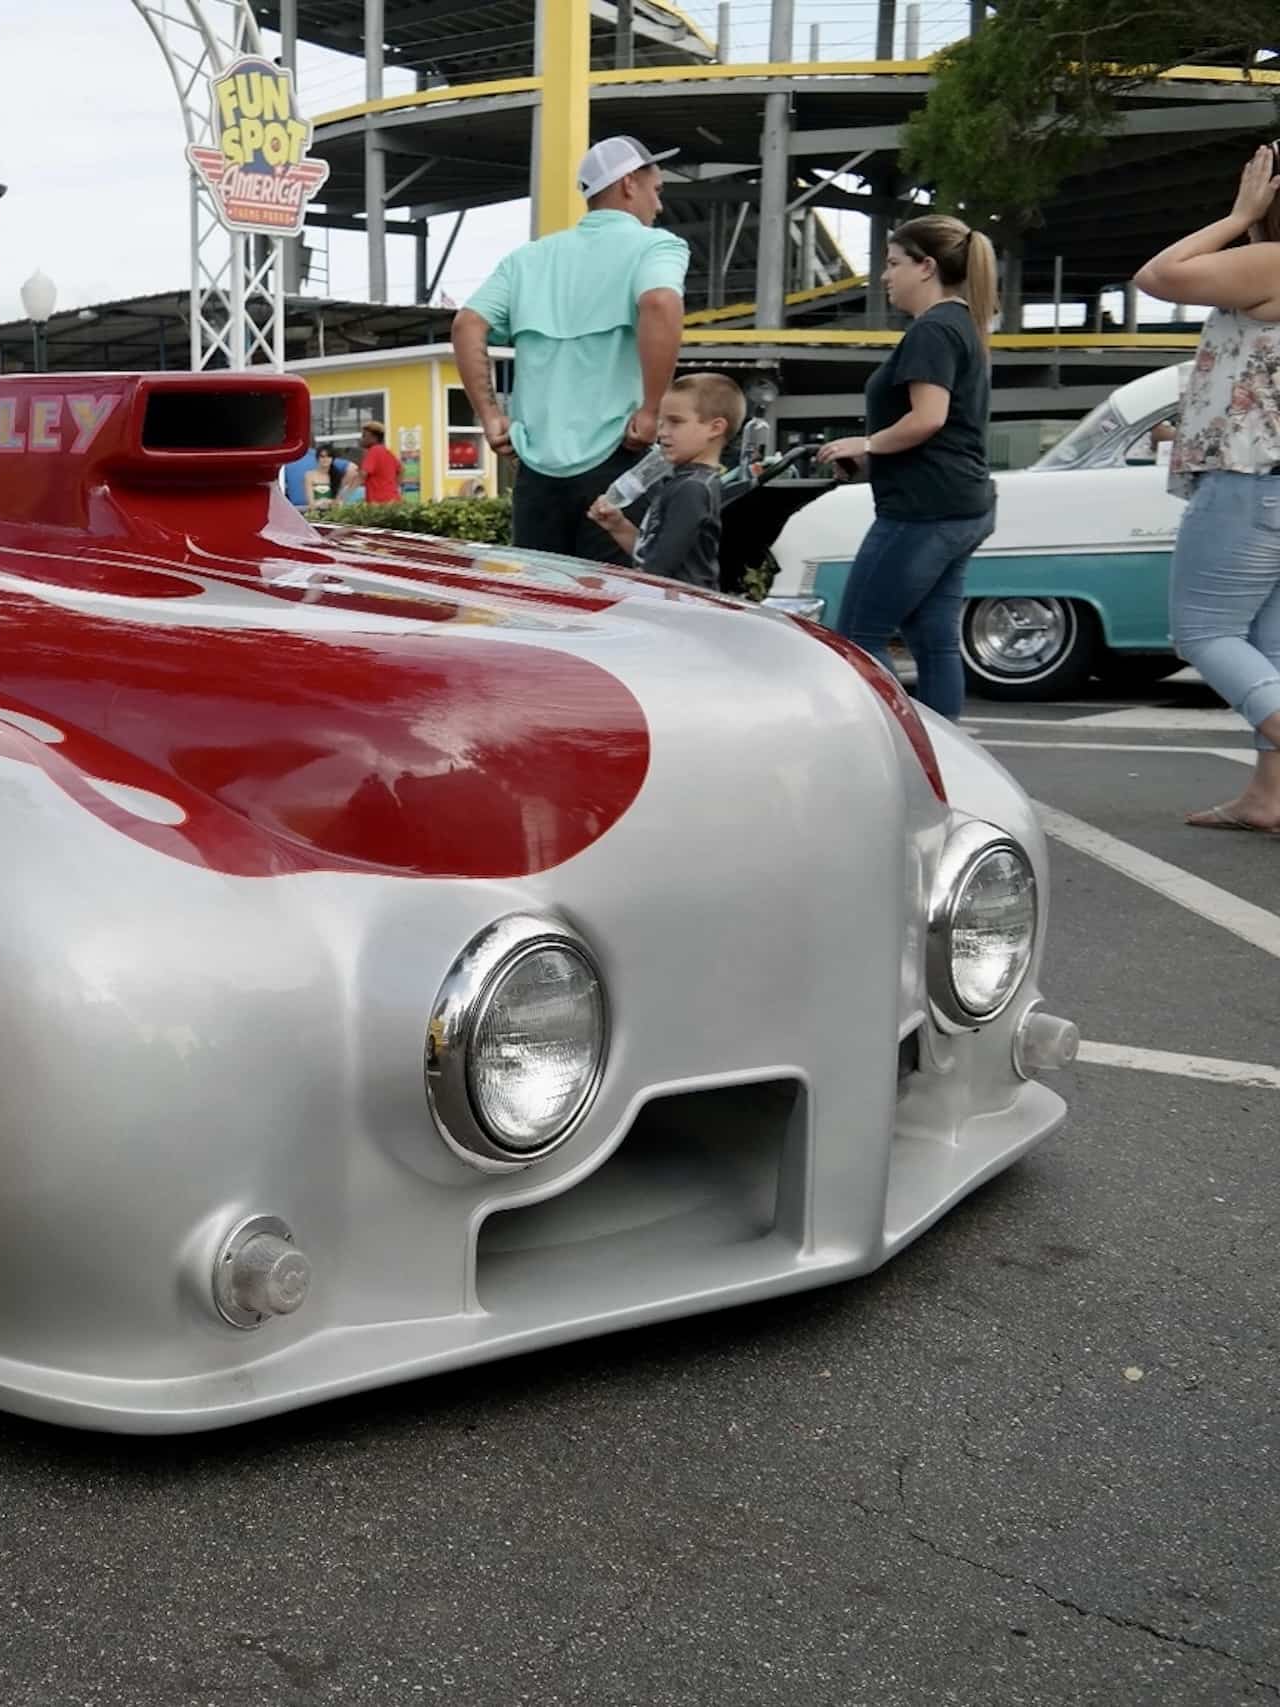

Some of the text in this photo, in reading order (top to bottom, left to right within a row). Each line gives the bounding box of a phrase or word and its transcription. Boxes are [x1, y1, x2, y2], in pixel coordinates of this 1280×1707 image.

[218, 71, 291, 127] FUN
[223, 118, 307, 169] SPOT
[219, 166, 304, 205] AMERICA
